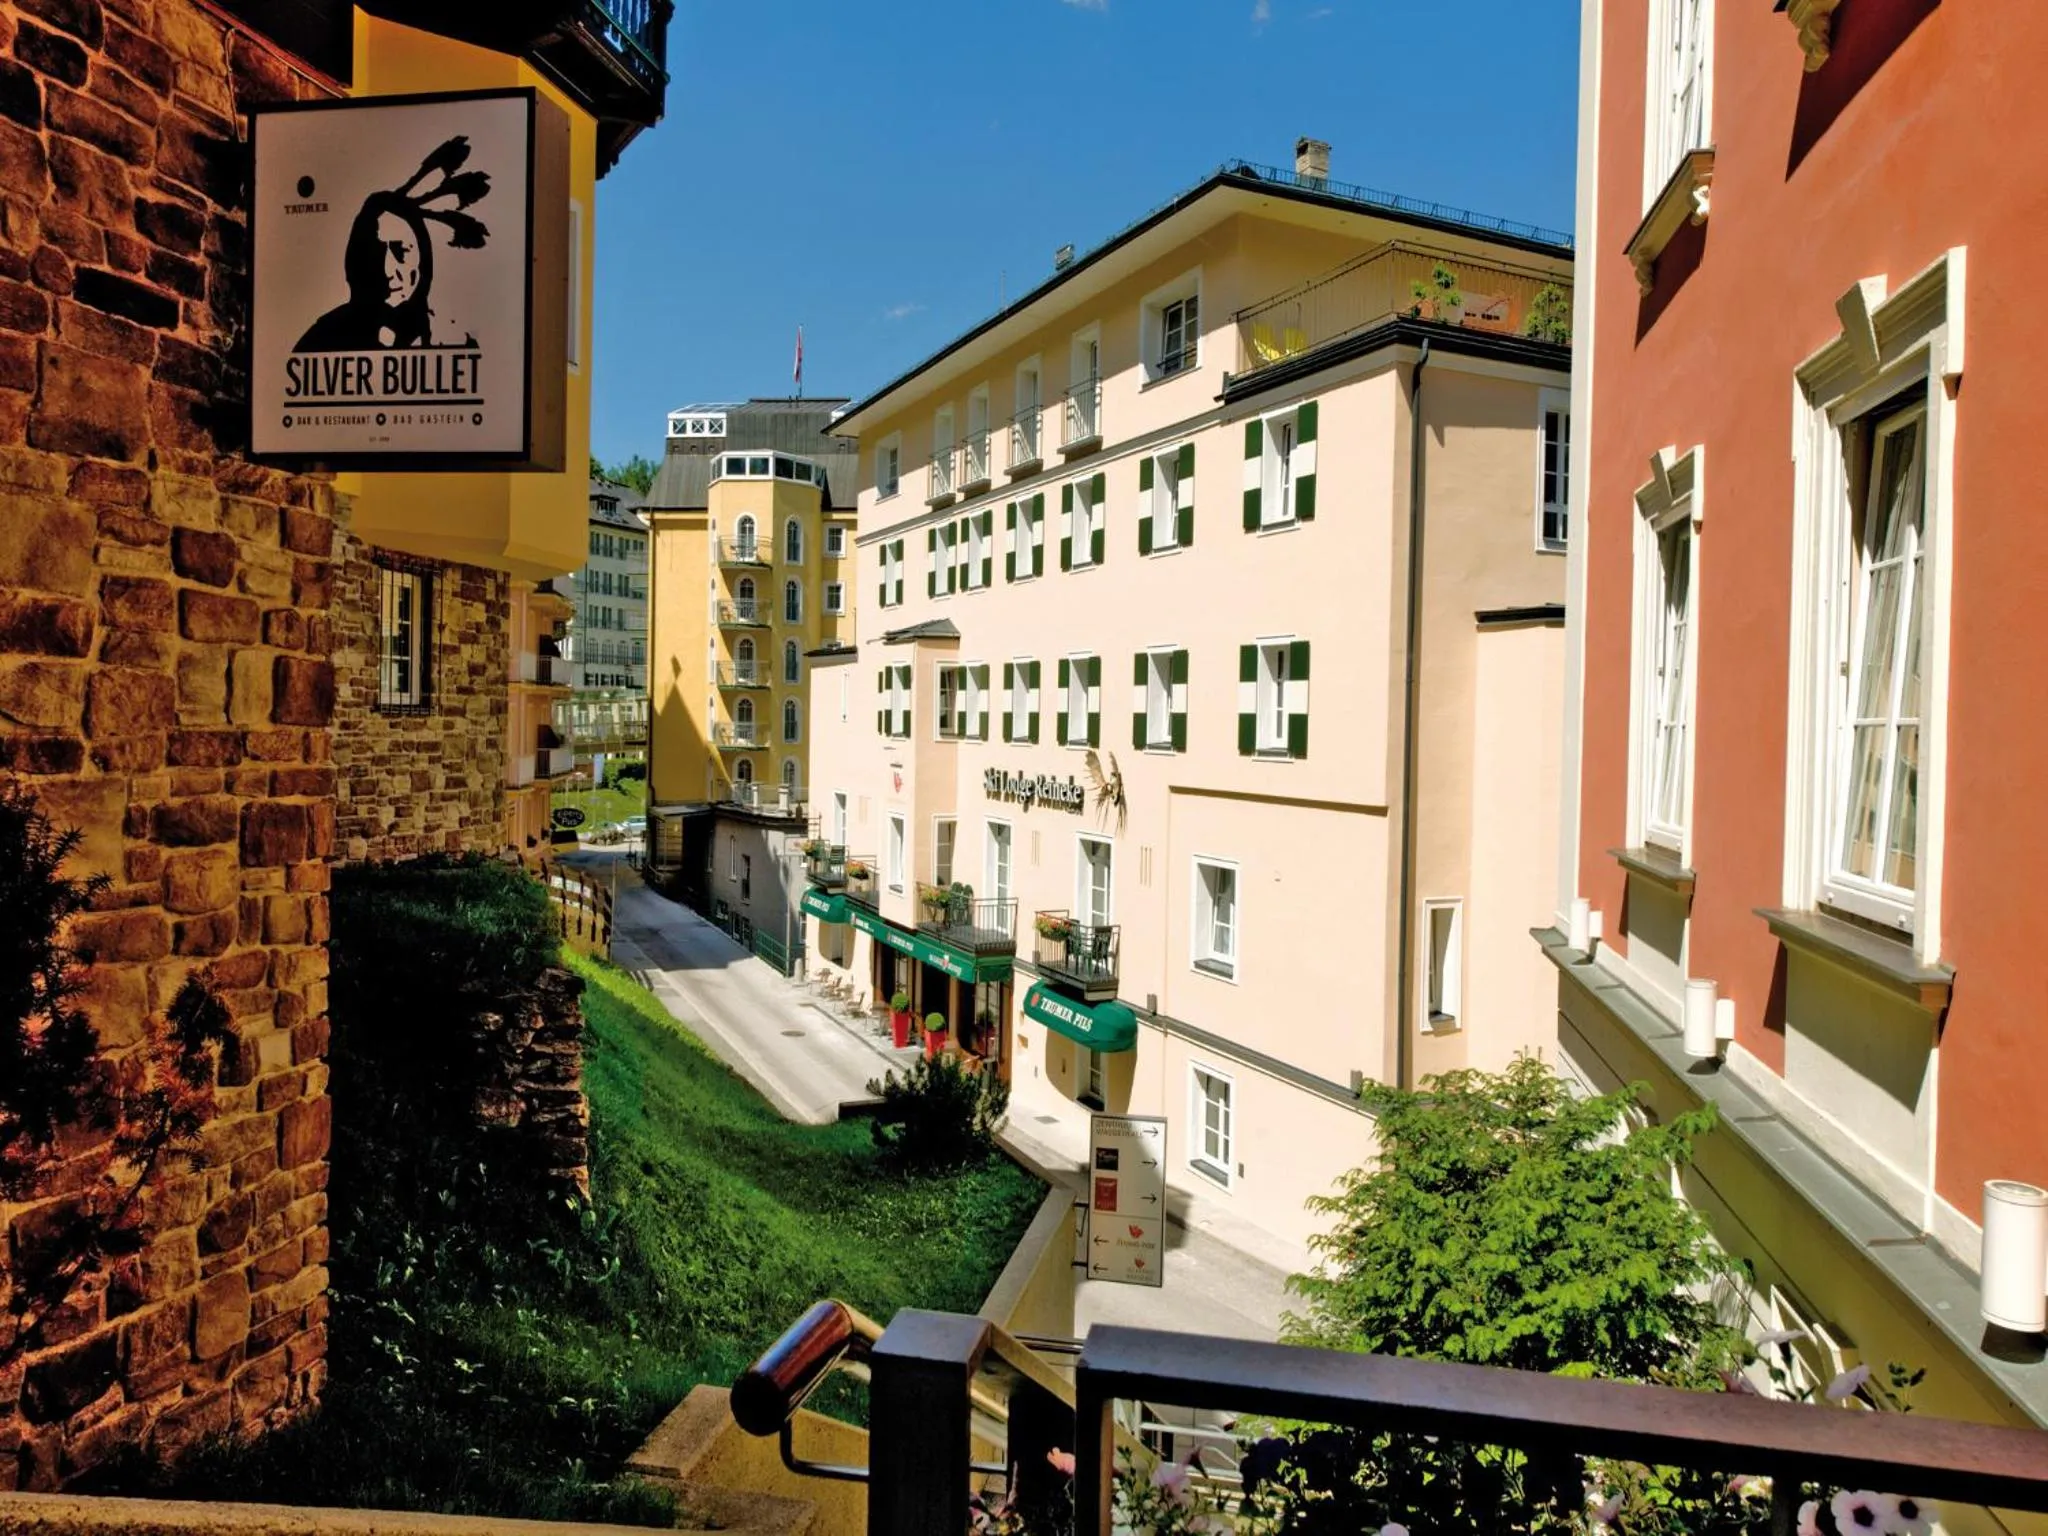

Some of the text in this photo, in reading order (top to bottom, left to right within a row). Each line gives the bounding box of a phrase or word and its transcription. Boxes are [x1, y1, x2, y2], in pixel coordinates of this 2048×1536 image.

[285, 353, 482, 397] SILVER BULLET
[323, 414, 370, 426] RESTAURANT
[420, 413, 464, 425] GASTEIN
[1001, 769, 1035, 803] Lodge
[1034, 773, 1083, 803] Reineke
[1040, 996, 1094, 1033] TRUMER PILS
